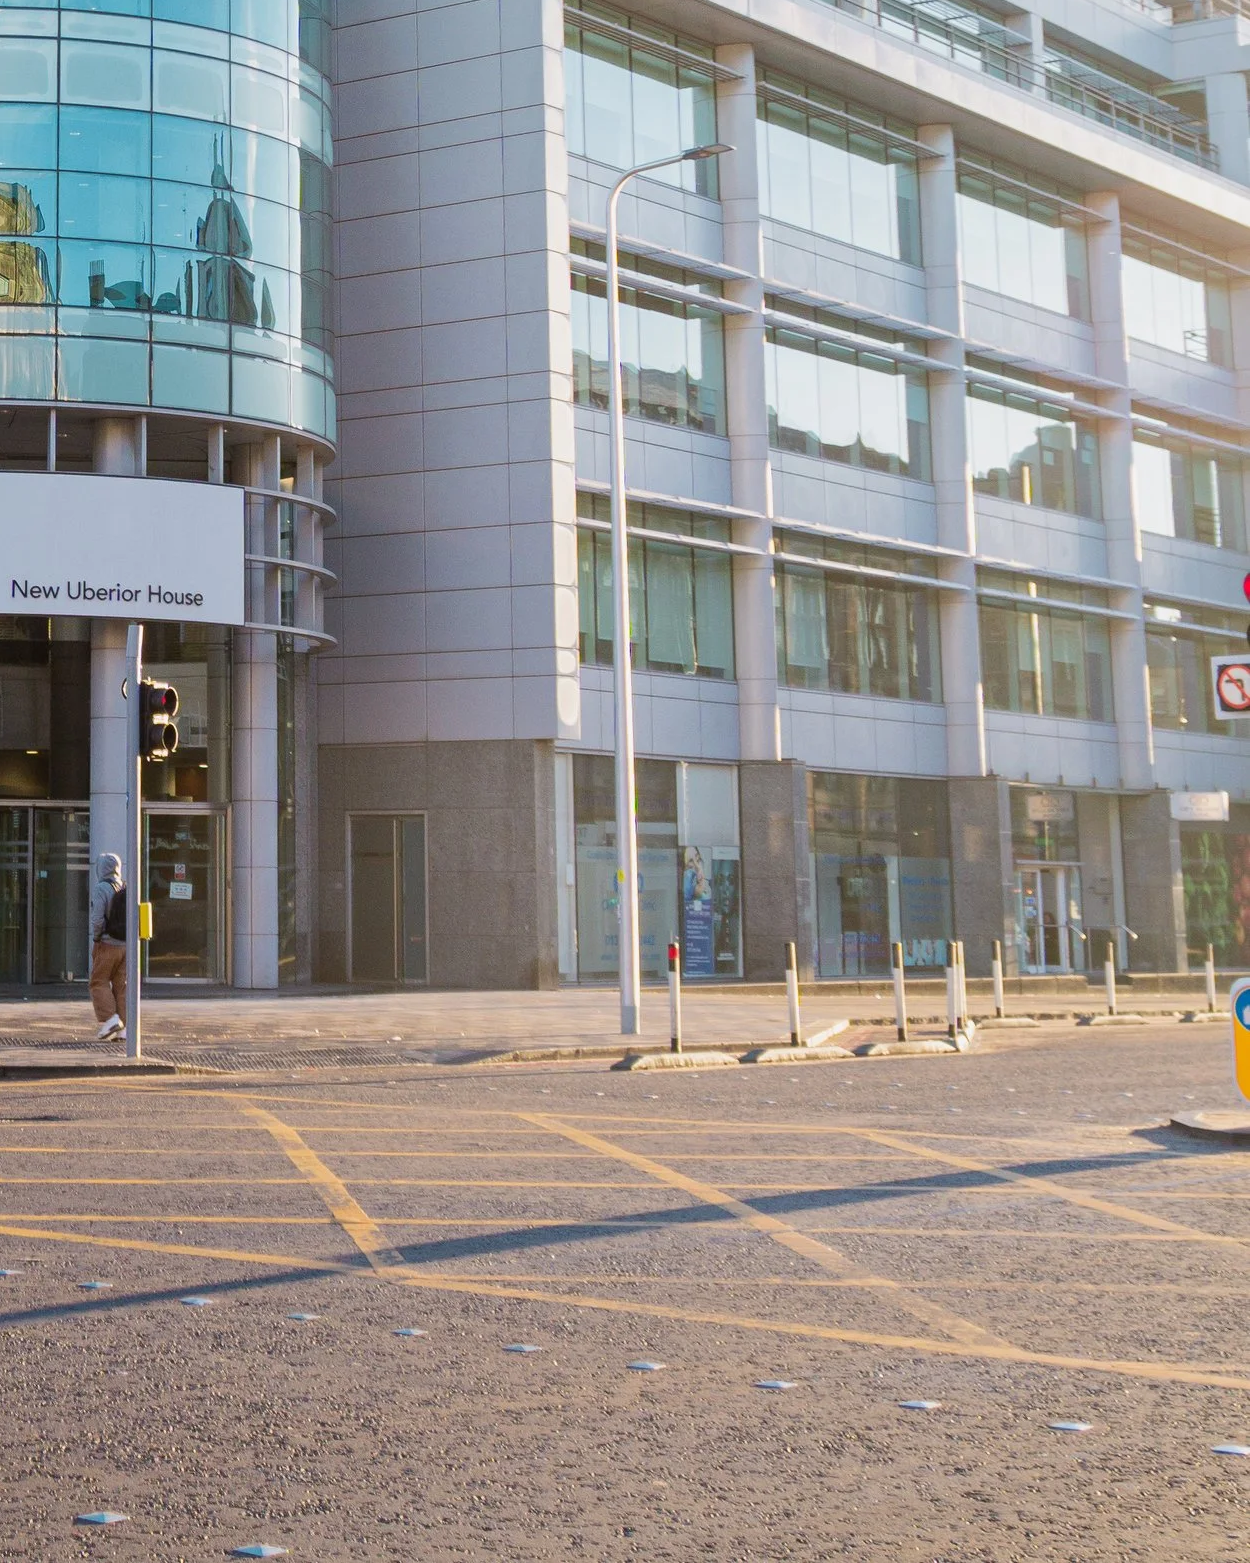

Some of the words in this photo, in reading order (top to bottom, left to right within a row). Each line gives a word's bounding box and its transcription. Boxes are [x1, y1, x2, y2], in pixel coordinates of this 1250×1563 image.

[11, 579, 60, 599] New
[67, 581, 142, 602] Uberior
[148, 584, 204, 606] House
